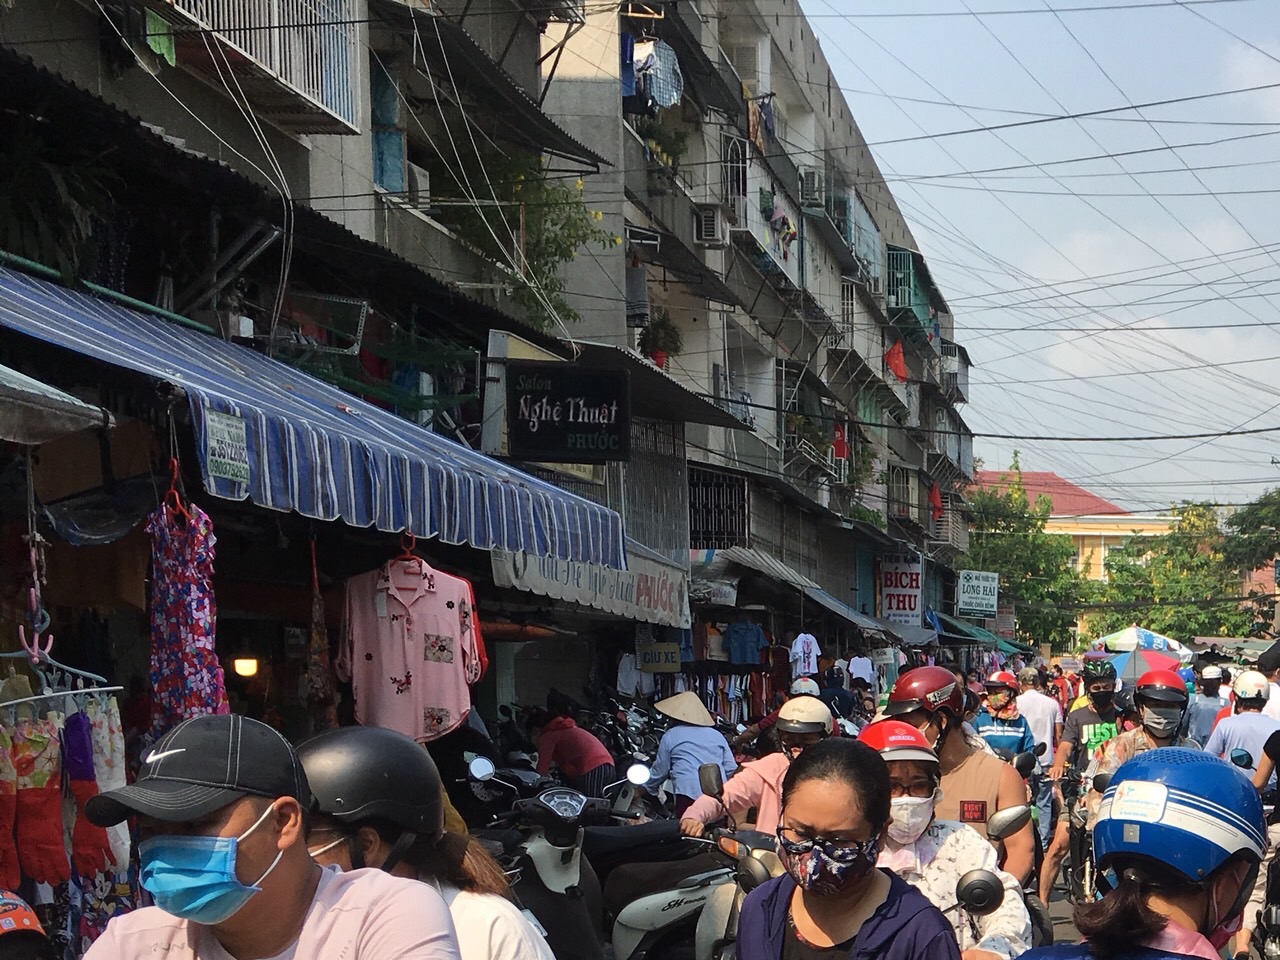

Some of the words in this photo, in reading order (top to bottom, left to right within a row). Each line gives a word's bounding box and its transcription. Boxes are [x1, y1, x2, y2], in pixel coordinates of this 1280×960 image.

[518, 394, 562, 432] Nghệ
[565, 397, 619, 428] Thuật
[883, 567, 921, 590] BÍCH
[962, 583, 981, 596] LONG
[885, 593, 918, 611] THU
[664, 651, 677, 664] XE
[1081, 723, 1118, 744] JUST
